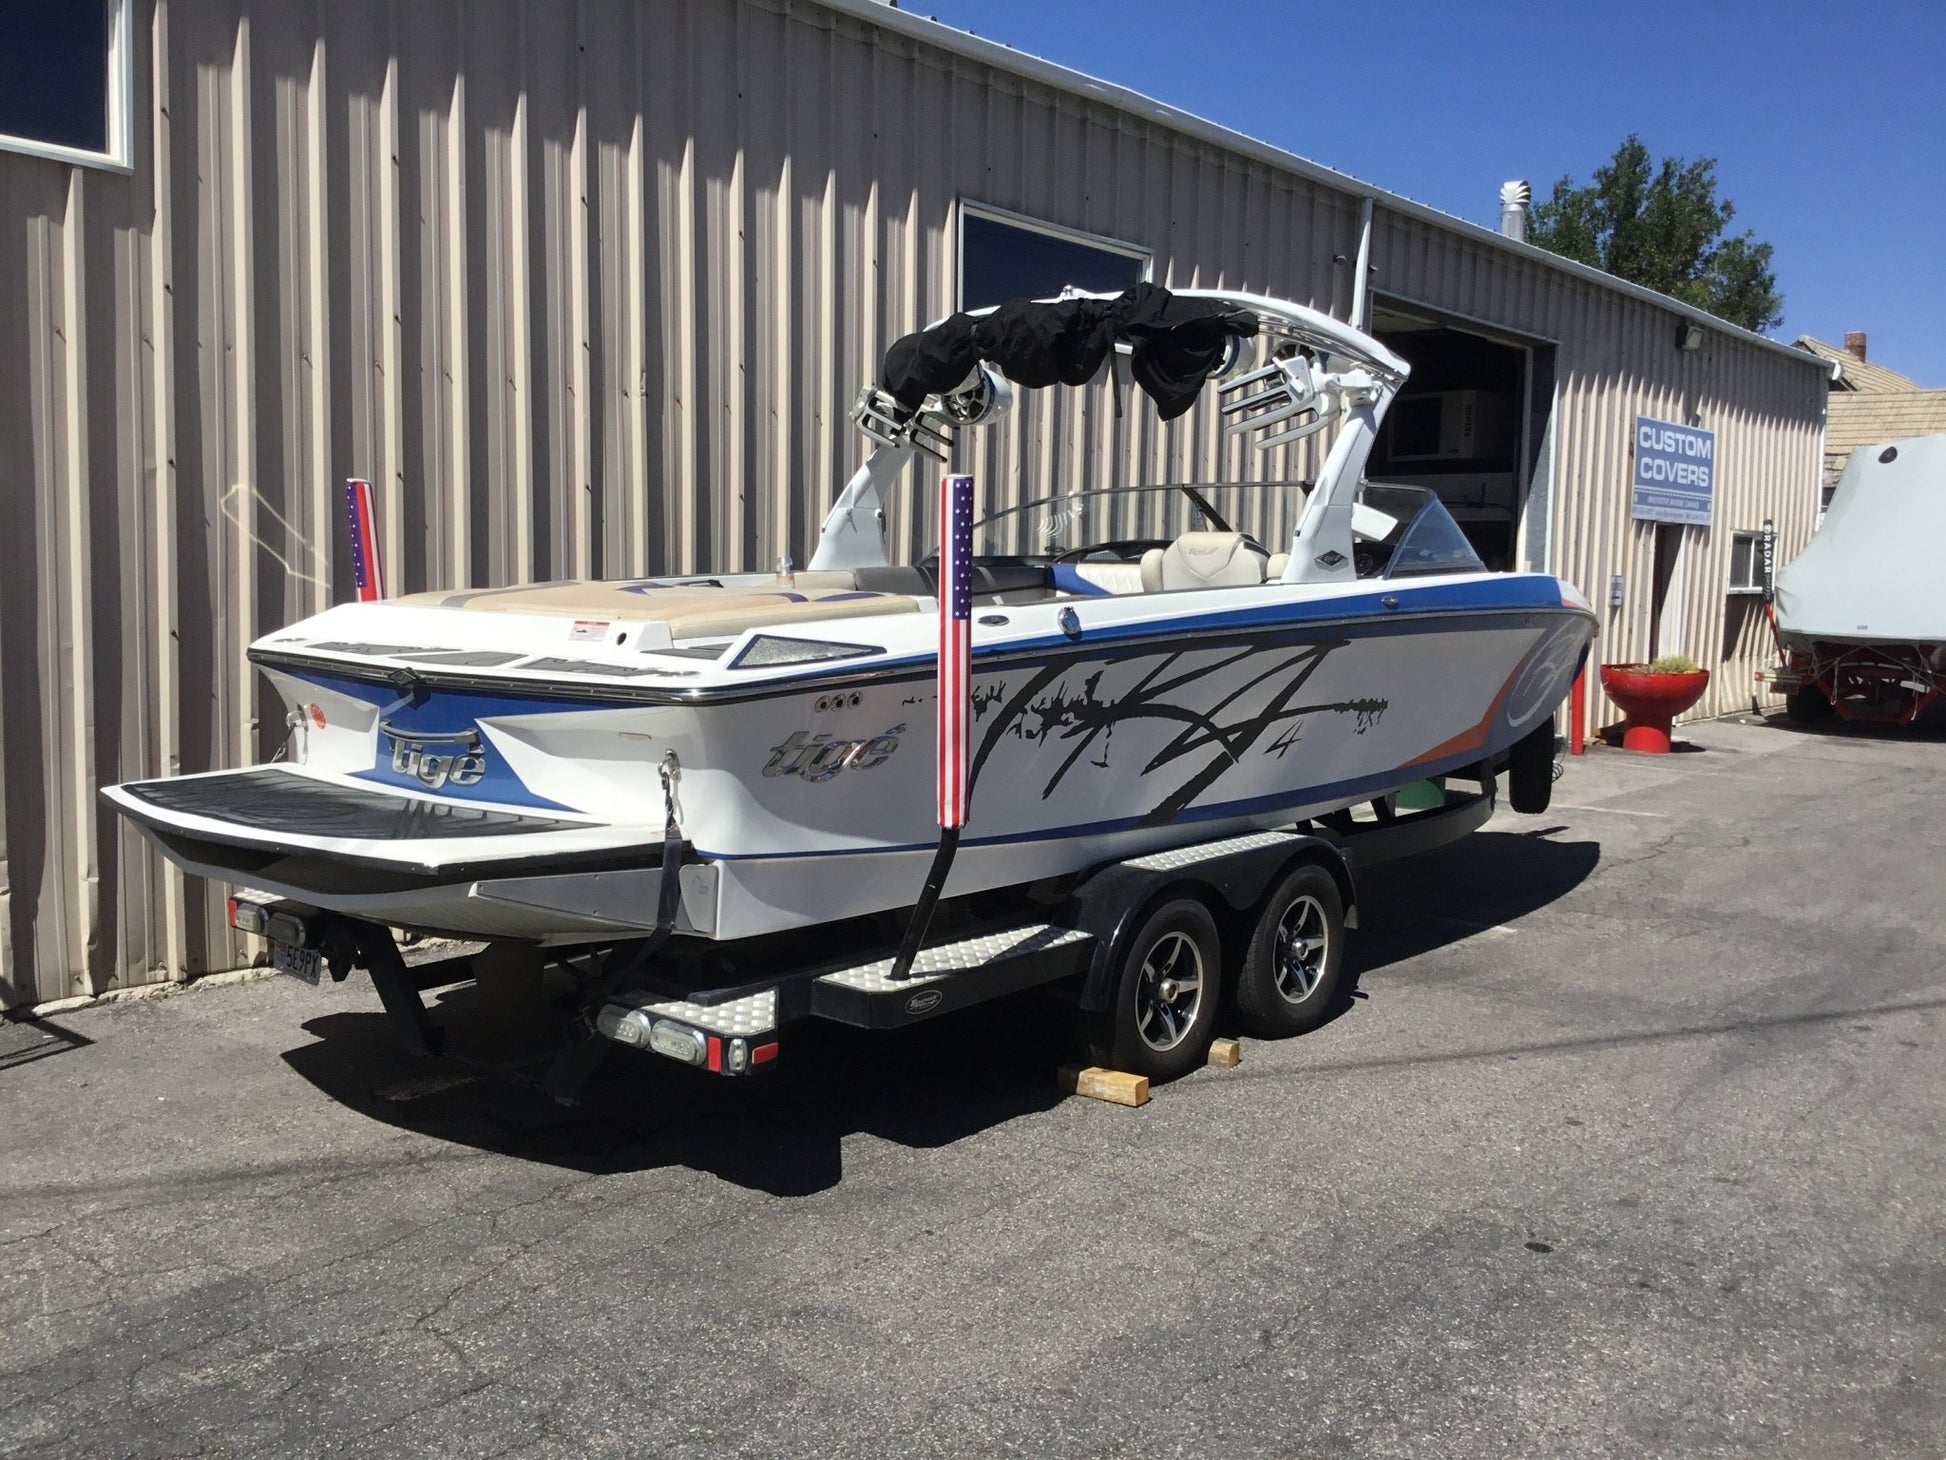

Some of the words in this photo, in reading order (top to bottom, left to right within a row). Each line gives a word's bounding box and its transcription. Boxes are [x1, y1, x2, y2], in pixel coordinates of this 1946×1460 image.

[1640, 426, 1711, 460] CUSTOM
[1640, 457, 1709, 487] COVERS
[1763, 534, 1772, 573] RADAR
